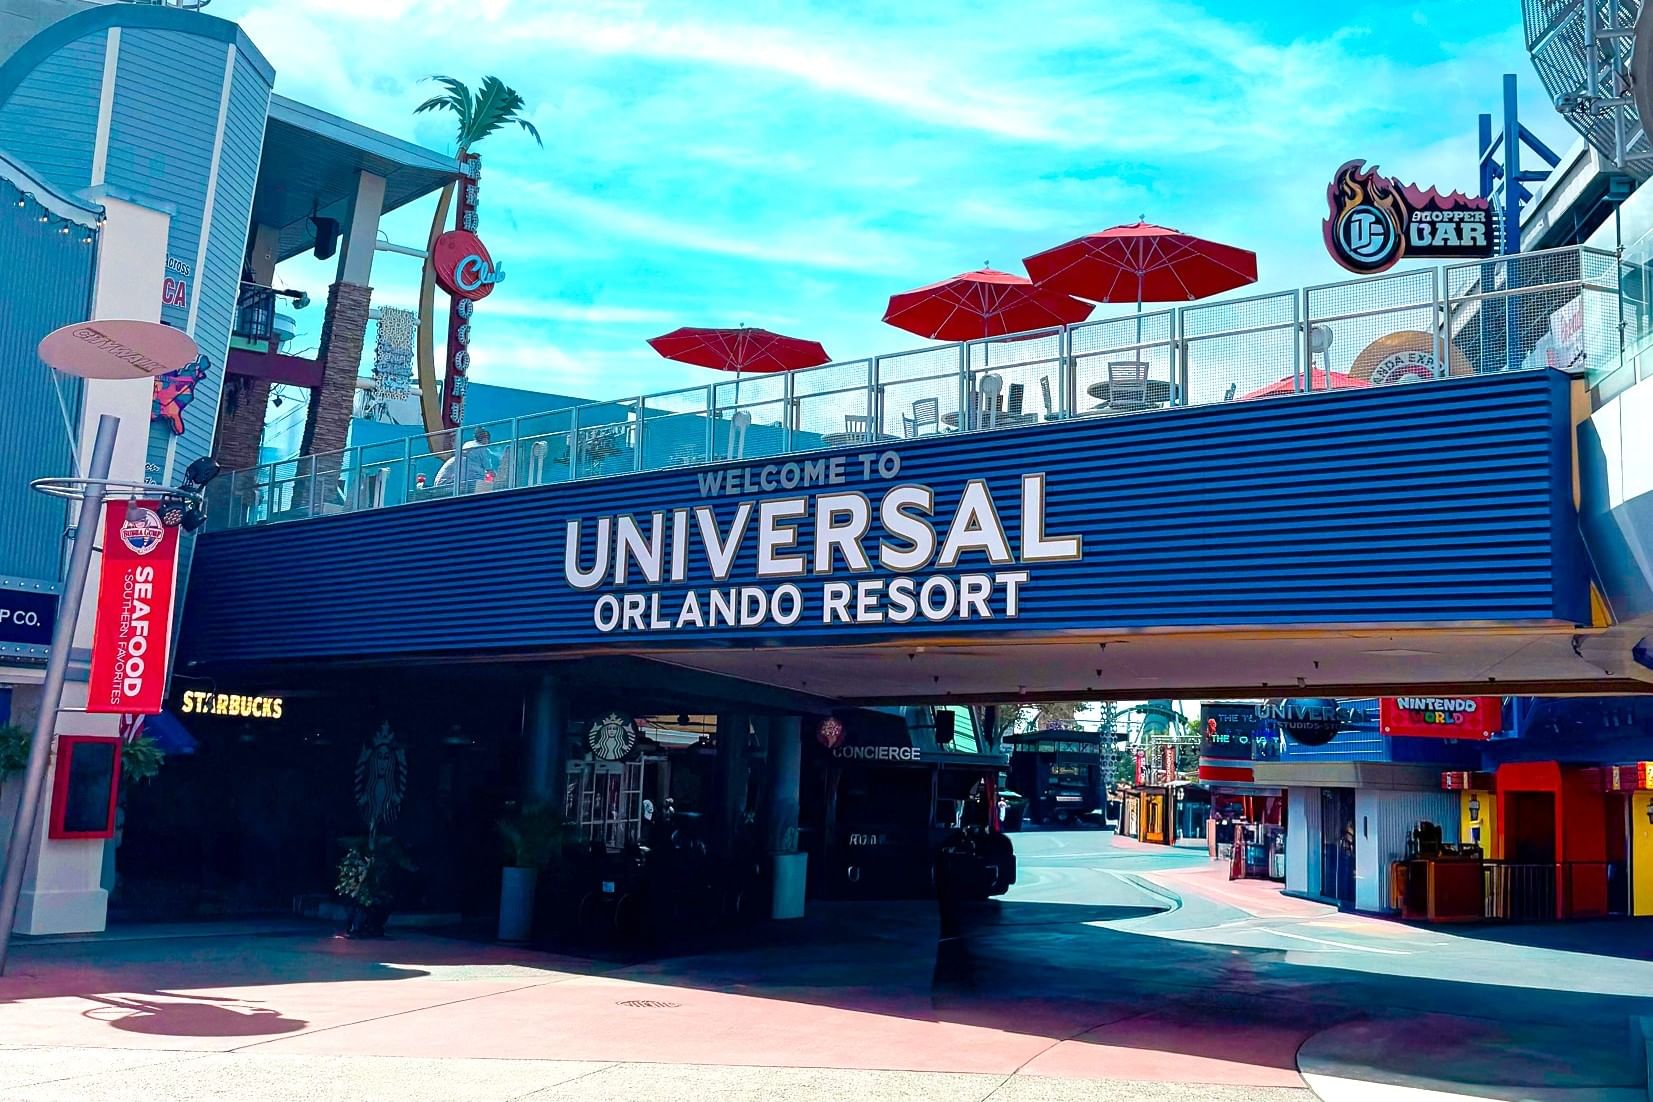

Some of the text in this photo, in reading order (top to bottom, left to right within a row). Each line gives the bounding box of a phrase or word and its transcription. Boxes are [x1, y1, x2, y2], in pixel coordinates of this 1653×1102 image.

[1409, 222, 1487, 247] BAR
[454, 254, 506, 291] Club
[697, 450, 901, 498] WELCOME TO
[564, 472, 1083, 591] UNIVERSAL
[13, 610, 41, 627] CO.
[593, 570, 1030, 632] ORLANDO RESORT
[110, 573, 135, 705] SOUTHERN FAVORITES
[123, 565, 154, 698] SEAFOOD
[1396, 697, 1477, 712] NINTENDO
[1211, 734, 1230, 743] THE
